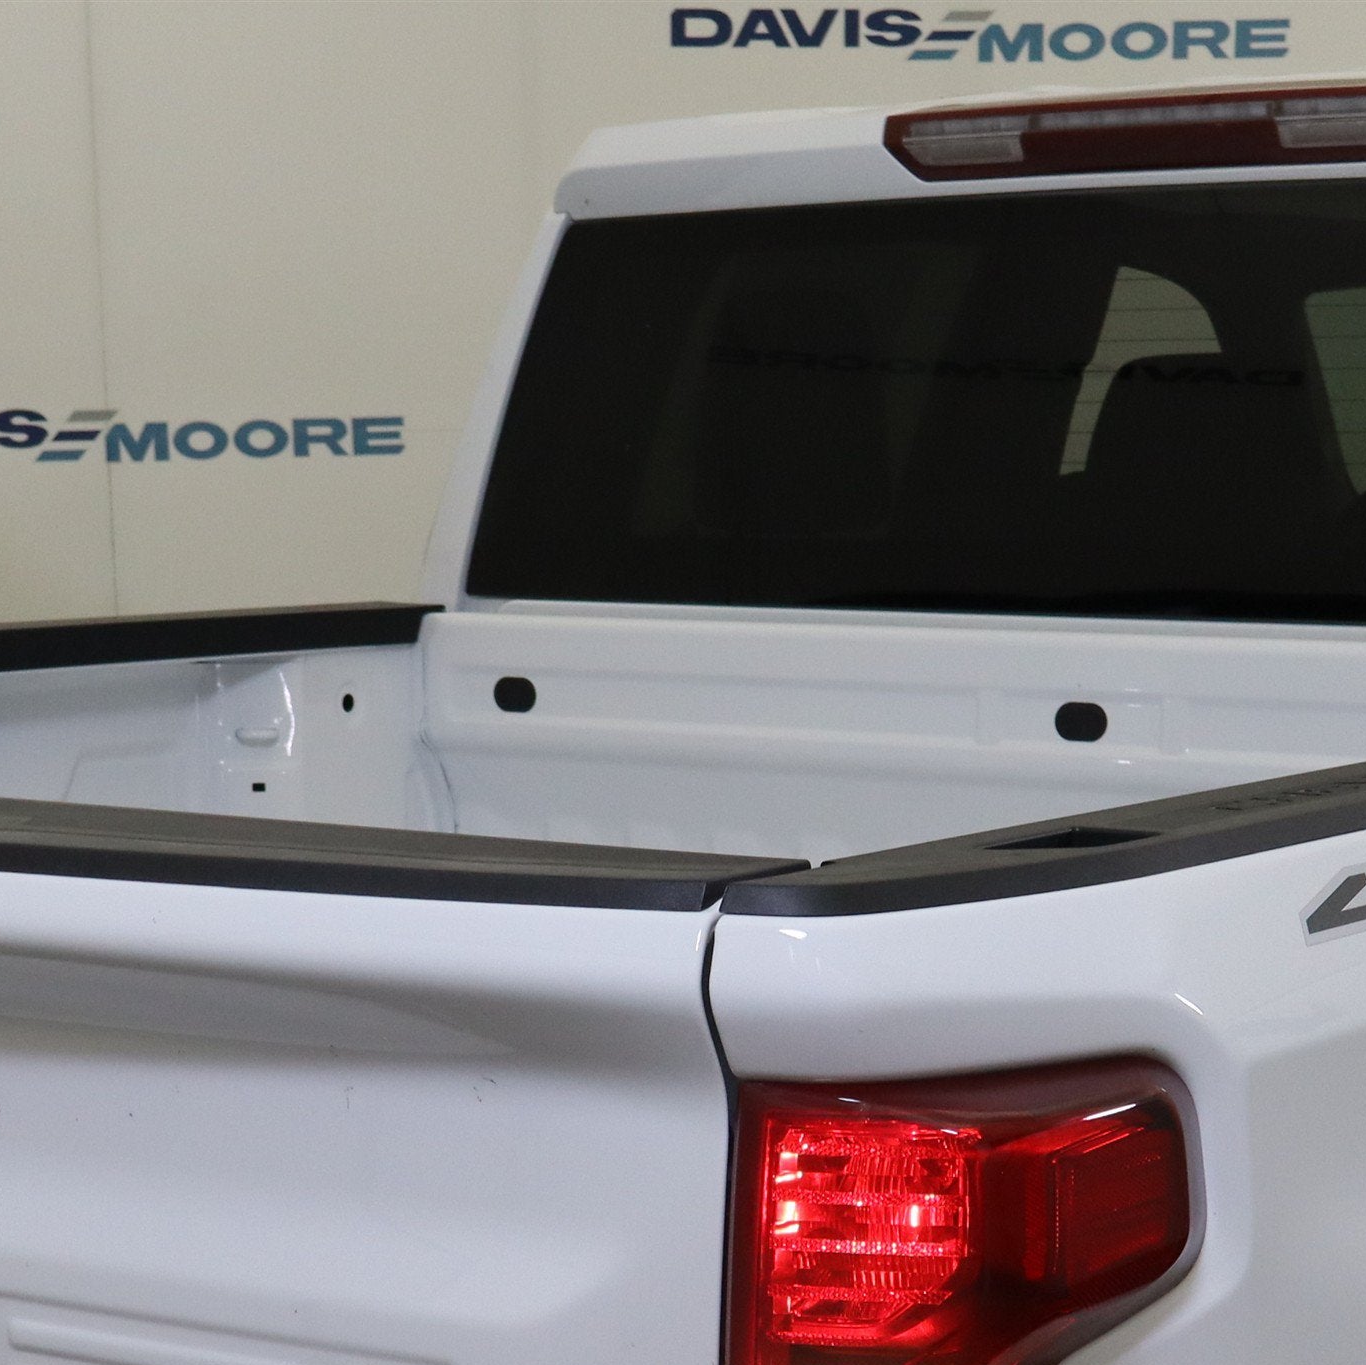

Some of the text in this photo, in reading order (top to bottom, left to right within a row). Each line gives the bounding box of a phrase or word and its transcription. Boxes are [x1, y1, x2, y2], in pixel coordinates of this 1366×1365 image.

[670, 9, 1291, 63] DAVIS MOORE
[105, 416, 406, 463] MOORE
